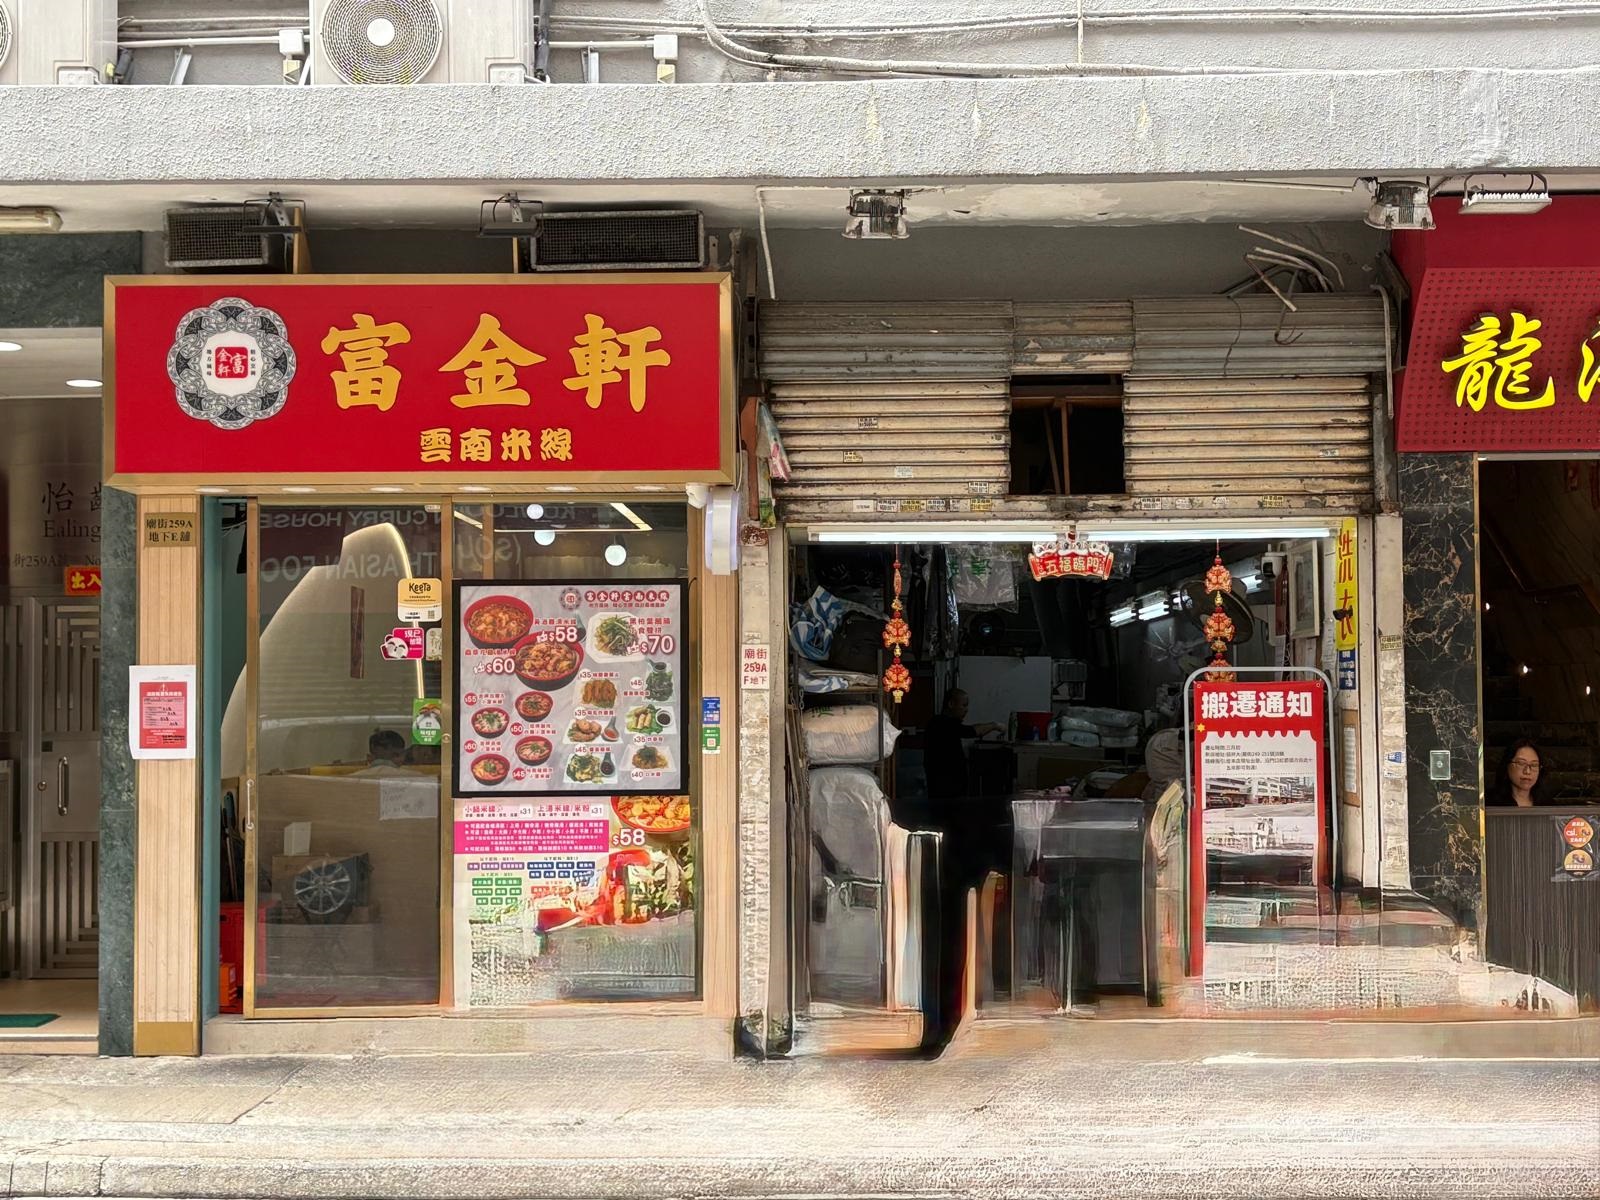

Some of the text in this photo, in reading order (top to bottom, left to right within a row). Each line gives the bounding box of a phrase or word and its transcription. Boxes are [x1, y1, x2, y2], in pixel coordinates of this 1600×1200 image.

[321, 313, 671, 413] 富金軒
[420, 428, 573, 463] 雲南米線
[1045, 556, 1100, 574] 五福臨門
[549, 626, 578, 642] $58
[641, 635, 674, 654] $70
[744, 648, 767, 660] 廟街
[486, 658, 515, 674] $60
[744, 662, 767, 673] 259A
[1201, 690, 1313, 719] 搬遷通知
[613, 829, 646, 846] $58
